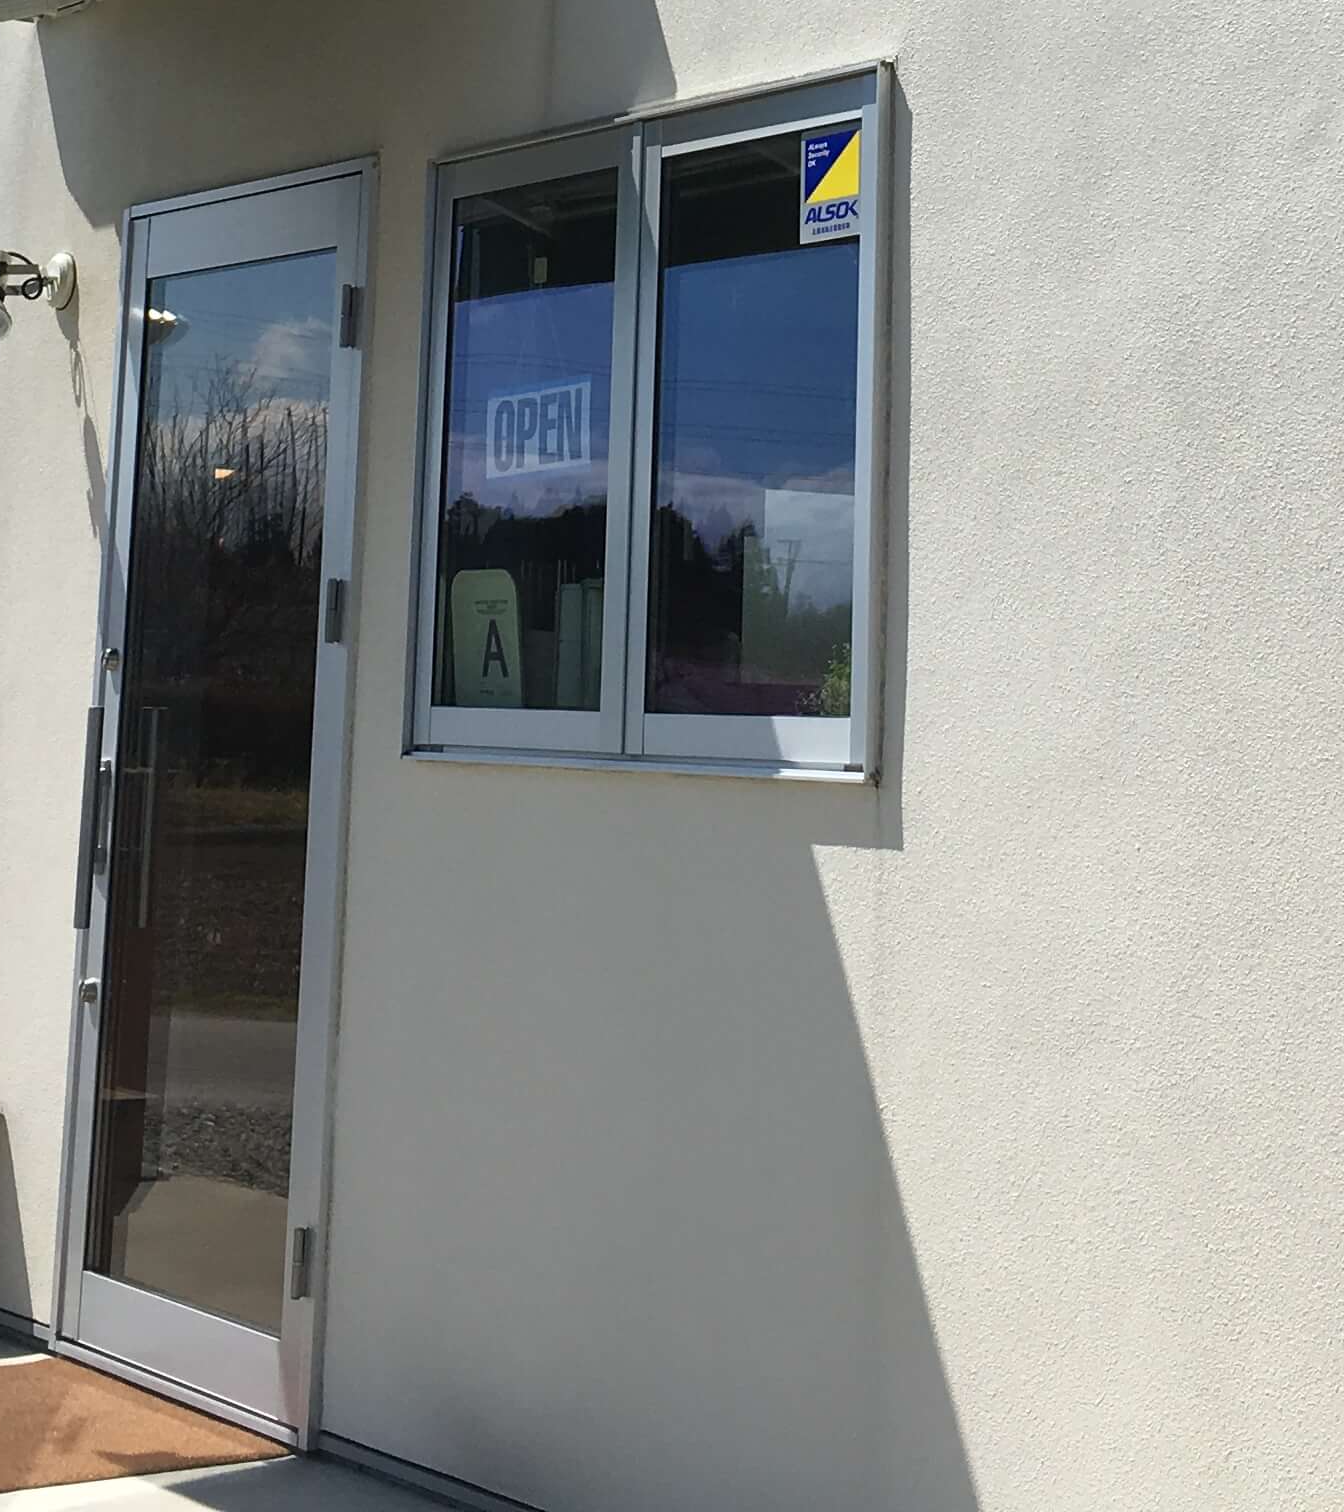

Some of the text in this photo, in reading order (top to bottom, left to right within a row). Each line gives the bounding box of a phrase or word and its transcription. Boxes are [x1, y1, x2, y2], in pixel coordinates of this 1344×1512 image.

[805, 199, 859, 225] ALSOK
[494, 387, 582, 473] OPEN
[481, 618, 509, 678] A
